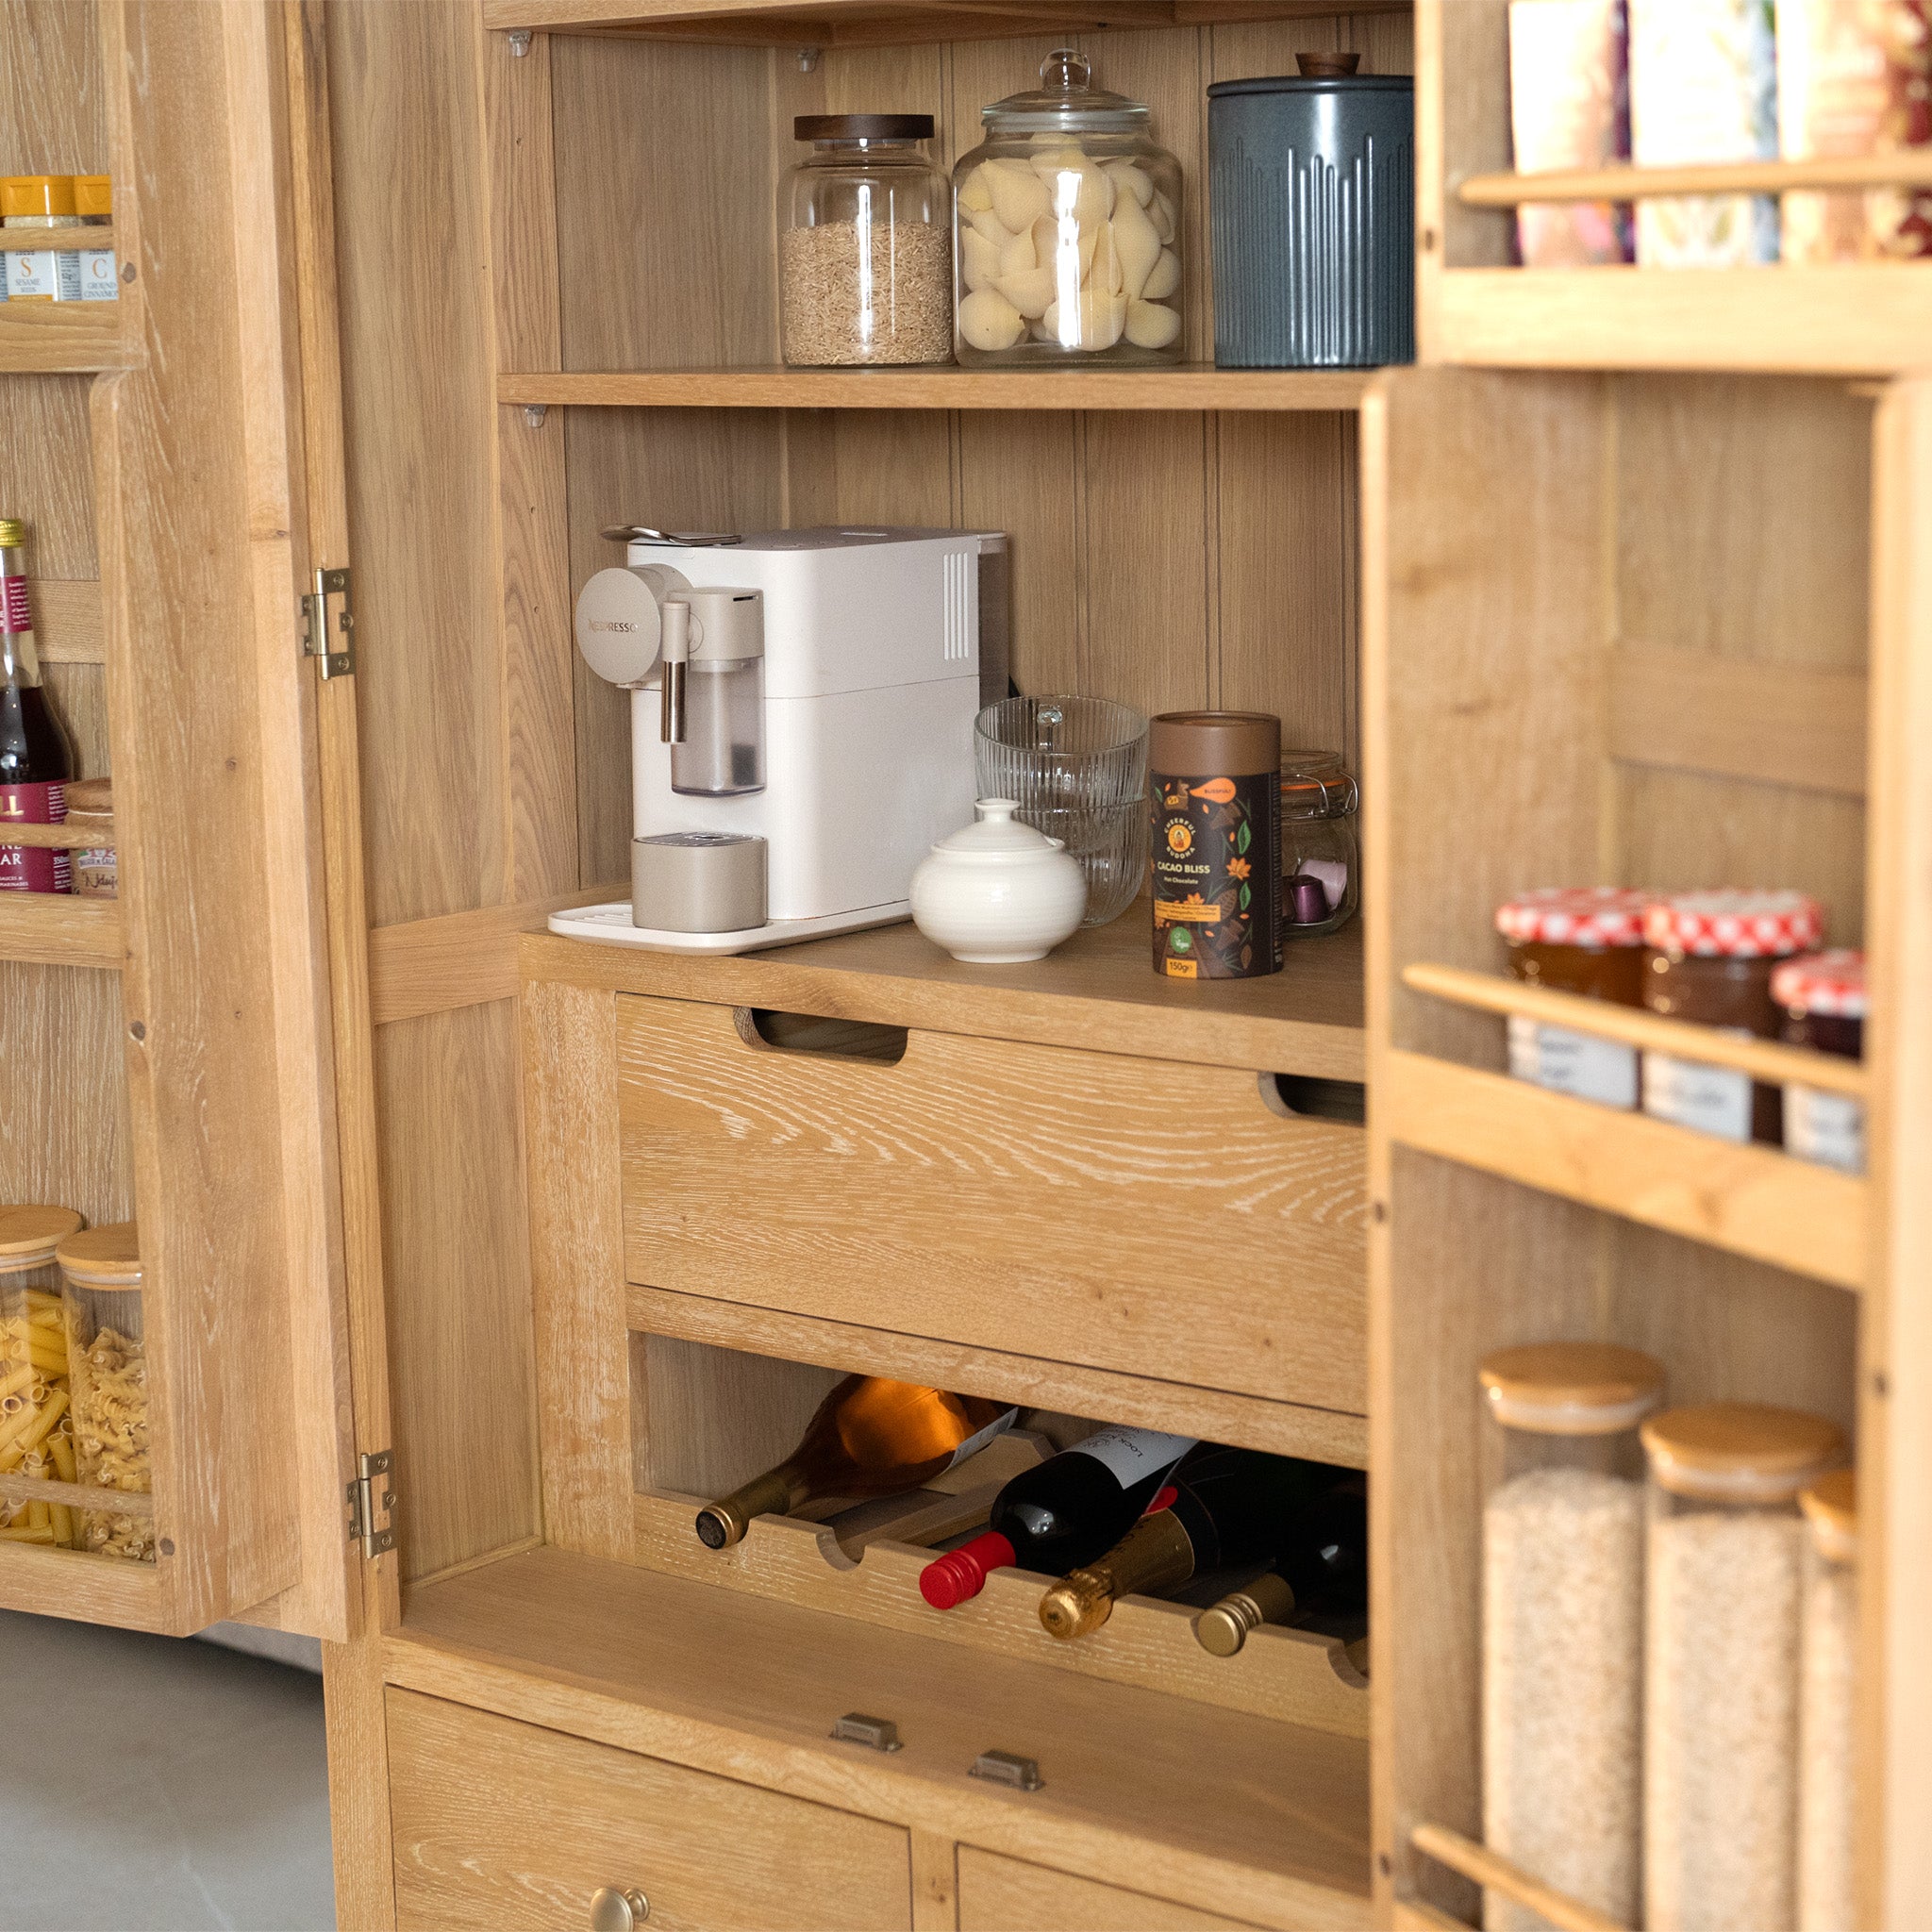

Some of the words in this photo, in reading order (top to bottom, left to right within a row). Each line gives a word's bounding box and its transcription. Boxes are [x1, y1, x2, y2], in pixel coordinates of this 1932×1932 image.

[20, 257, 32, 277] S
[92, 258, 108, 278] C
[1163, 817, 1197, 836] CHEERFUL
[1157, 861, 1183, 873] CACAO
[1184, 864, 1211, 874] BLISS
